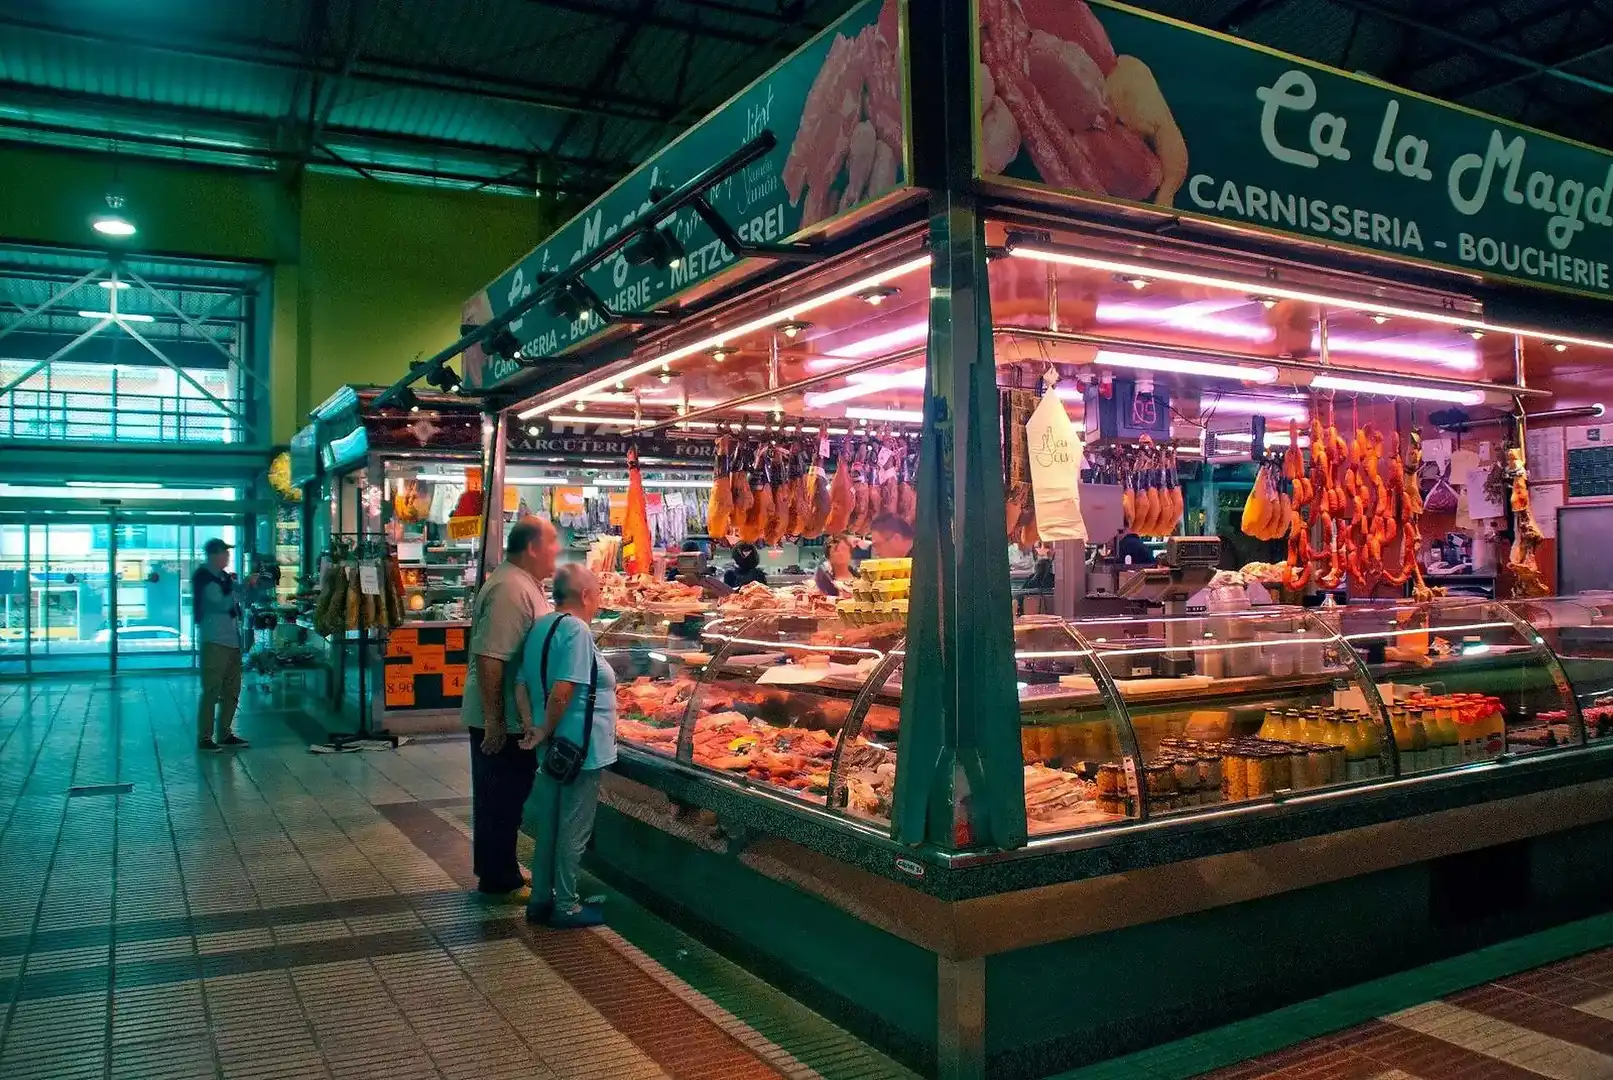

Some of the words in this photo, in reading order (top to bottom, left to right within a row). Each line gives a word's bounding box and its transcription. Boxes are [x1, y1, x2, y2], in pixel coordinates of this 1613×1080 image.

[1256, 69, 1351, 169] Ca
[1372, 99, 1432, 181] la
[1188, 174, 1424, 252] CARNISSERIA
[1458, 231, 1610, 289] BOUCHERIE
